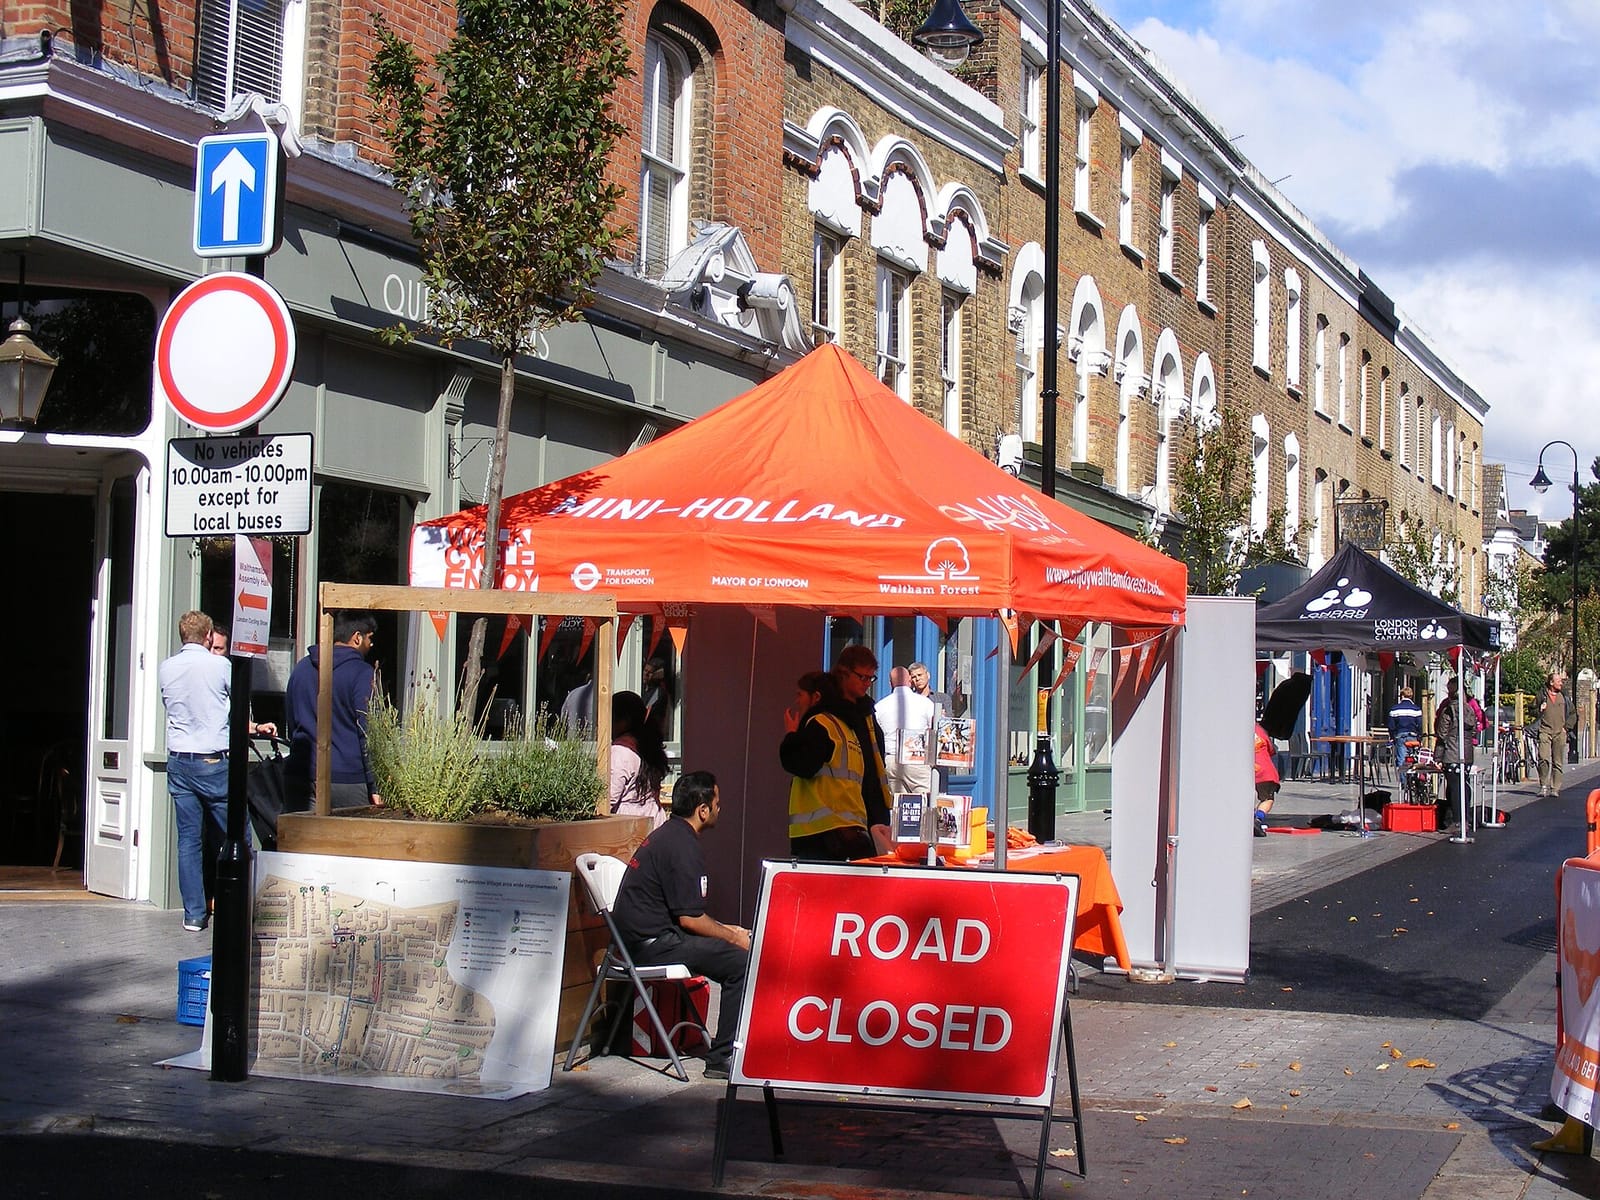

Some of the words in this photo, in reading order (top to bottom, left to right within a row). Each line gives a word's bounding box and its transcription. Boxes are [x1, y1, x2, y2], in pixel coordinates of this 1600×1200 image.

[194, 443, 215, 459] No
[222, 441, 283, 459] vehicles
[172, 467, 232, 485] 10.00am
[245, 464, 307, 485] 10.00pm
[198, 488, 250, 509] except
[257, 487, 278, 504] for
[194, 512, 230, 531] local
[237, 512, 282, 529] buses
[549, 496, 906, 528] MINI-HOLLAND
[445, 547, 536, 569] CYLE
[445, 568, 540, 592] ENOY
[712, 577, 746, 585] MAYOR
[748, 578, 762, 586] OF
[764, 578, 808, 588] LONDON
[880, 584, 935, 594] Waltham
[940, 585, 979, 594] Forest
[1375, 620, 1417, 628] LONDON
[831, 912, 991, 963] ROAD
[787, 995, 1013, 1052] CLOSED
[1581, 1060, 1598, 1081] GET
